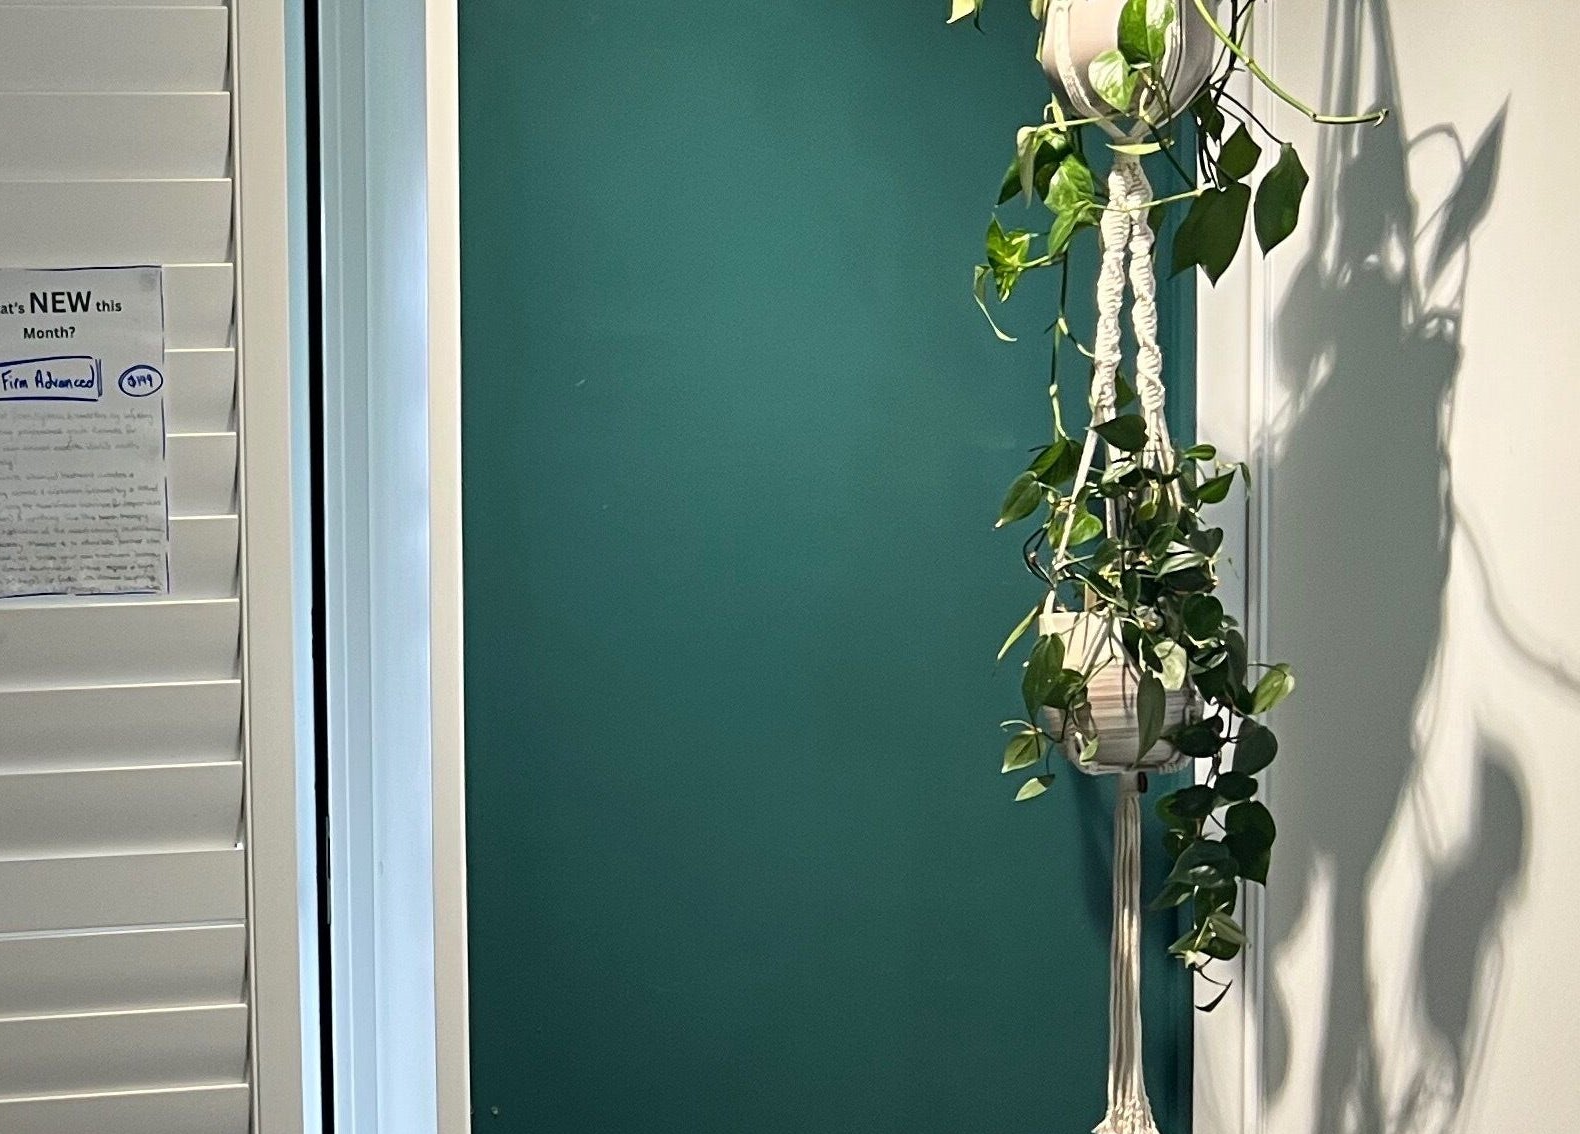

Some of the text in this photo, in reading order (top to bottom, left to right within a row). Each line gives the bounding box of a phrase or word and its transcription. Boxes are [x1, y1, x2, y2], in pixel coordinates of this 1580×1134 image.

[30, 291, 91, 314] NEW
[96, 299, 122, 313] this
[23, 326, 76, 340] Month?
[1, 369, 29, 391] Firm
[35, 364, 95, 389] Advanced
